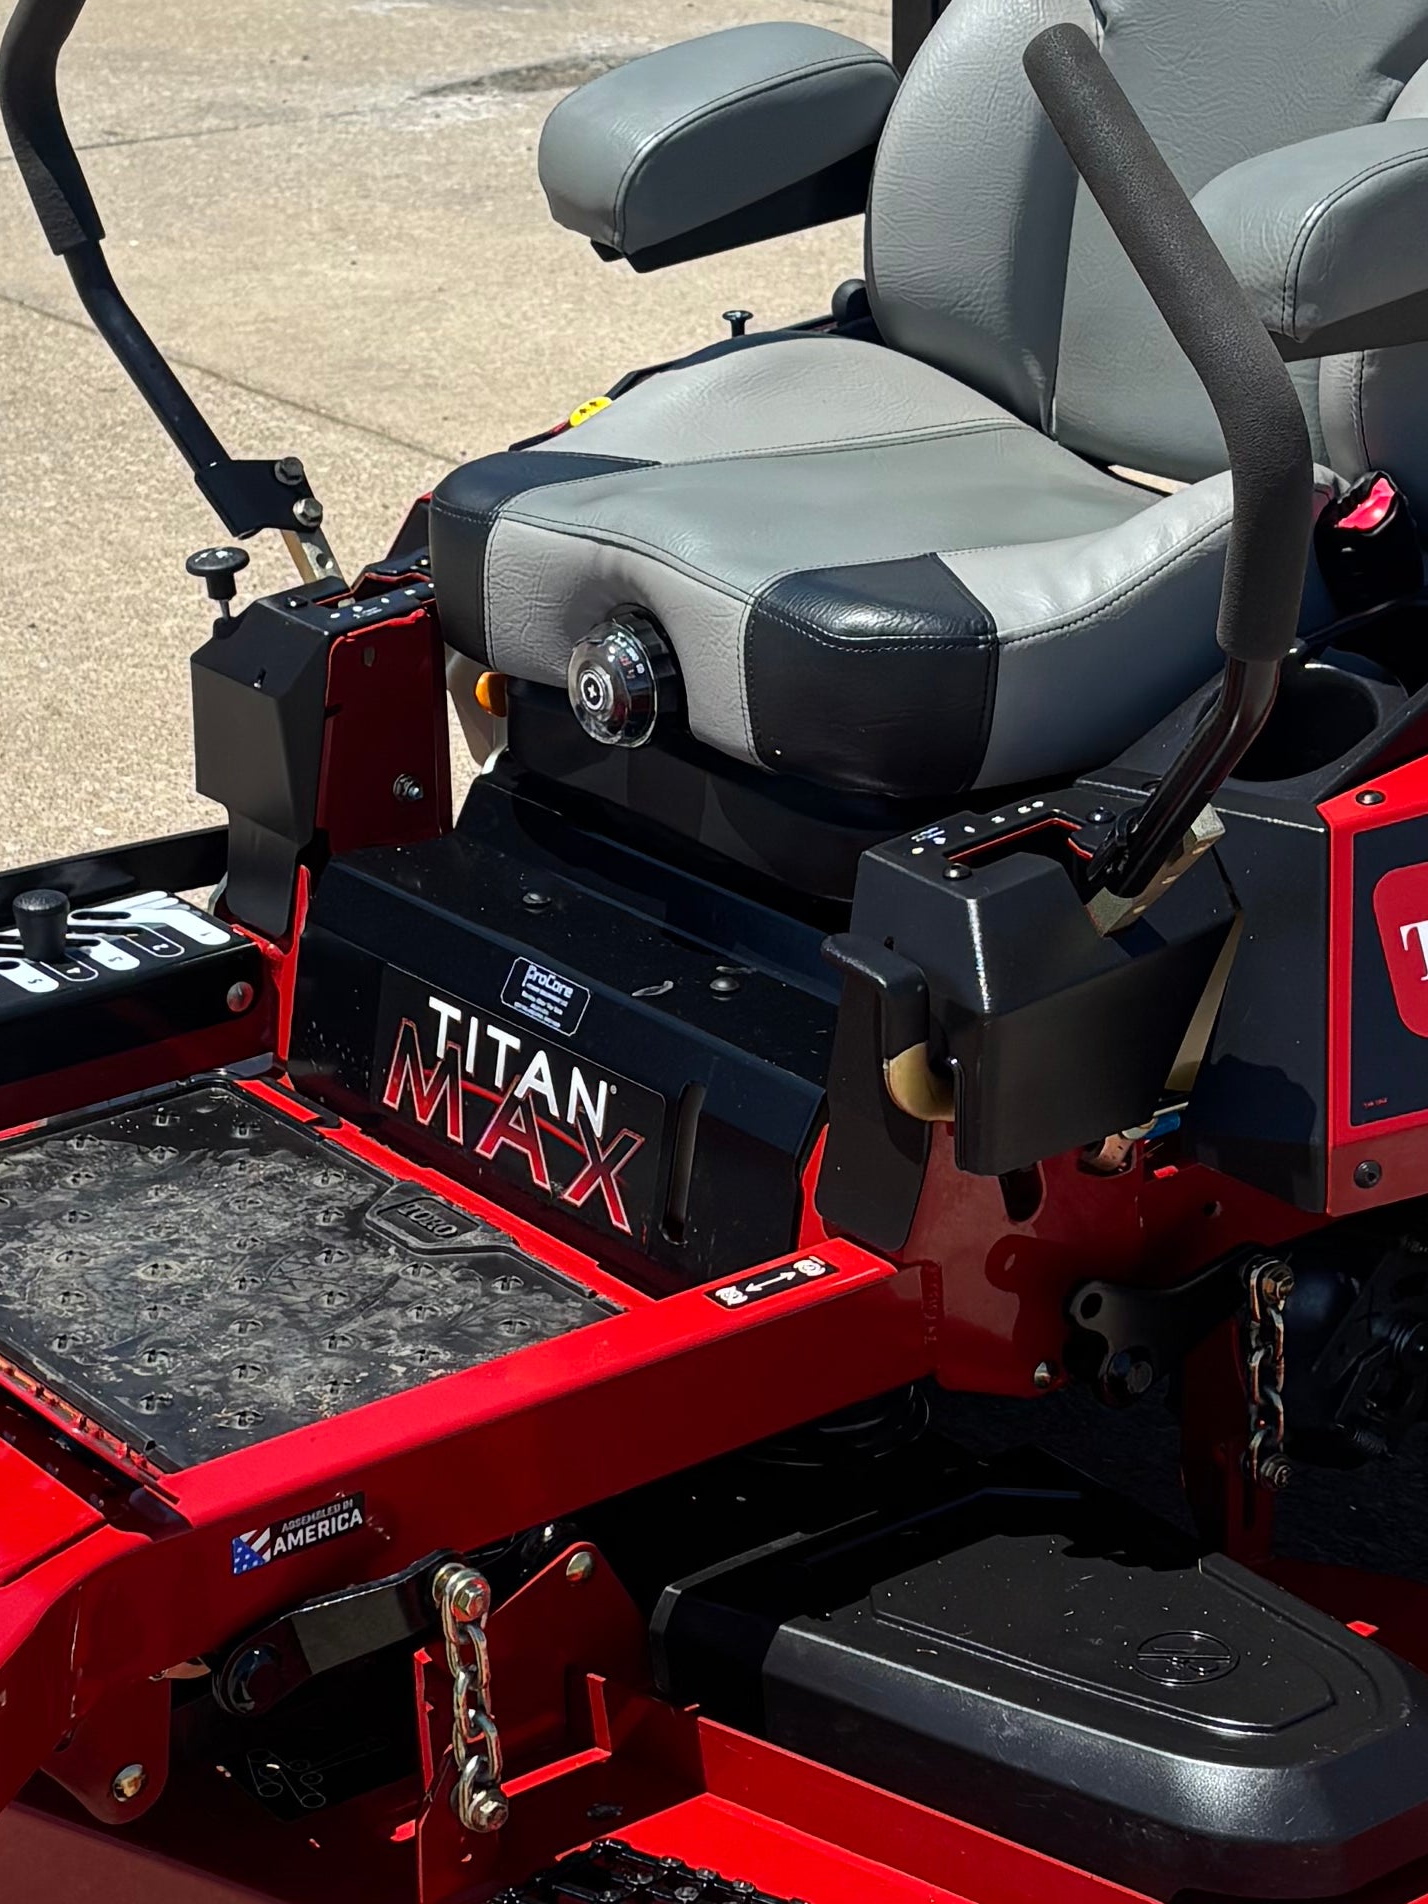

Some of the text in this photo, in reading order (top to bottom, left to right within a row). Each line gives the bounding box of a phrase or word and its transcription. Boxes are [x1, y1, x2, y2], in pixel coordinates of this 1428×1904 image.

[427, 995, 611, 1138] TITAN
[381, 1017, 646, 1238] MAX
[396, 1202, 458, 1238] TORO
[272, 1507, 364, 1556] AMERICA
